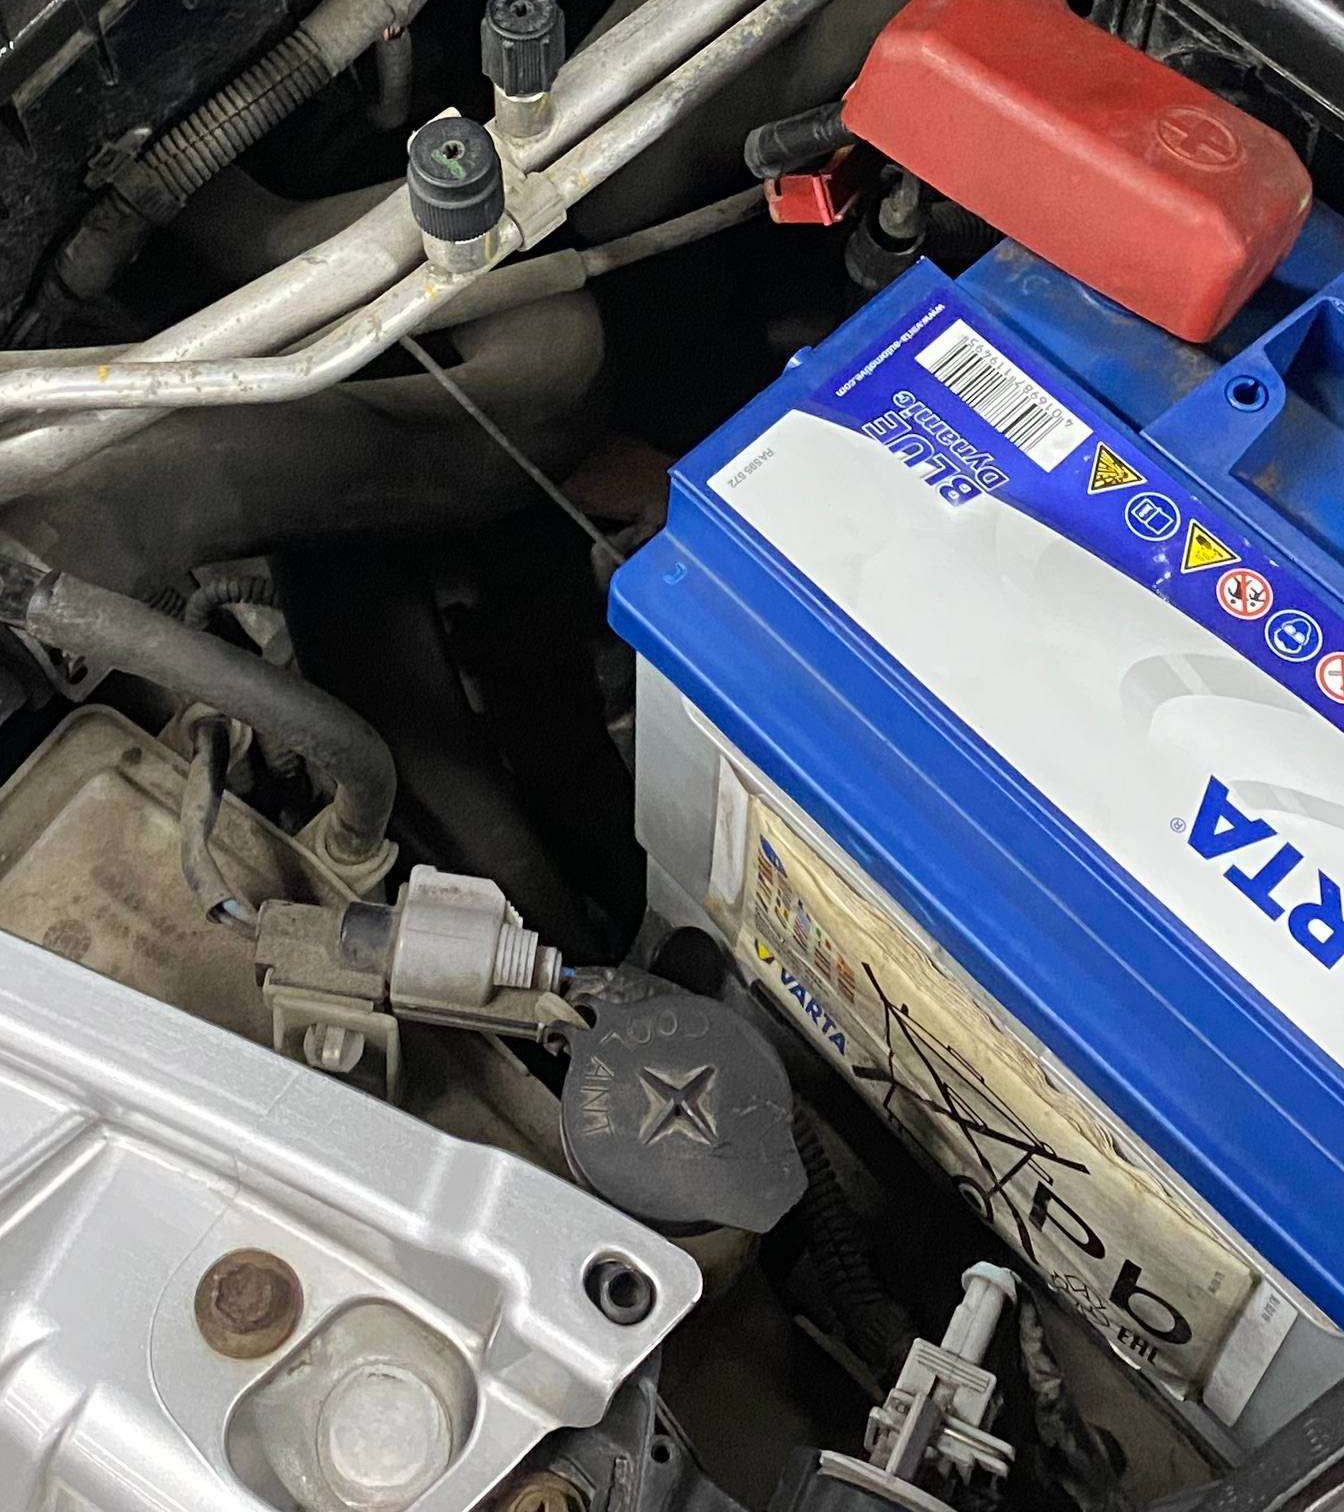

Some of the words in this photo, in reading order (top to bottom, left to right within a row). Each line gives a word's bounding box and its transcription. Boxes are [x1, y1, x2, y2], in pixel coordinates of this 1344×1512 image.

[835, 303, 946, 398] www.varta-automotive.com
[862, 410, 982, 508] BLUE
[891, 390, 1010, 491] Dynamic
[778, 969, 851, 1057] VARTA
[1027, 1180, 1193, 1346] Pb
